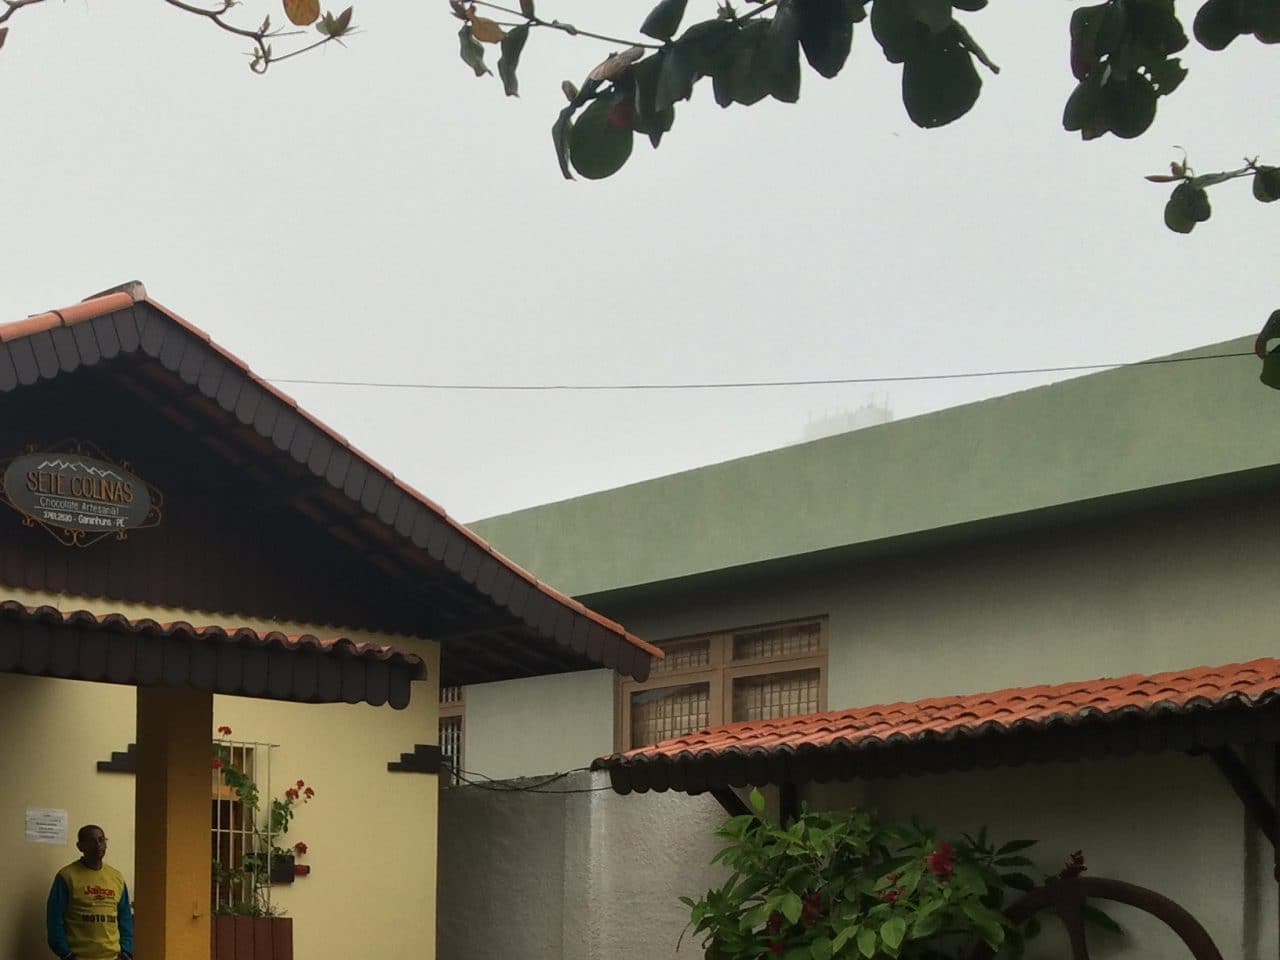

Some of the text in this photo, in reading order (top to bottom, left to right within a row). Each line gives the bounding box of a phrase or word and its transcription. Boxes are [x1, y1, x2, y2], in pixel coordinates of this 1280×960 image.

[26, 471, 134, 504] SETE COLINAS
[39, 496, 119, 515] Chocolate Artesanal
